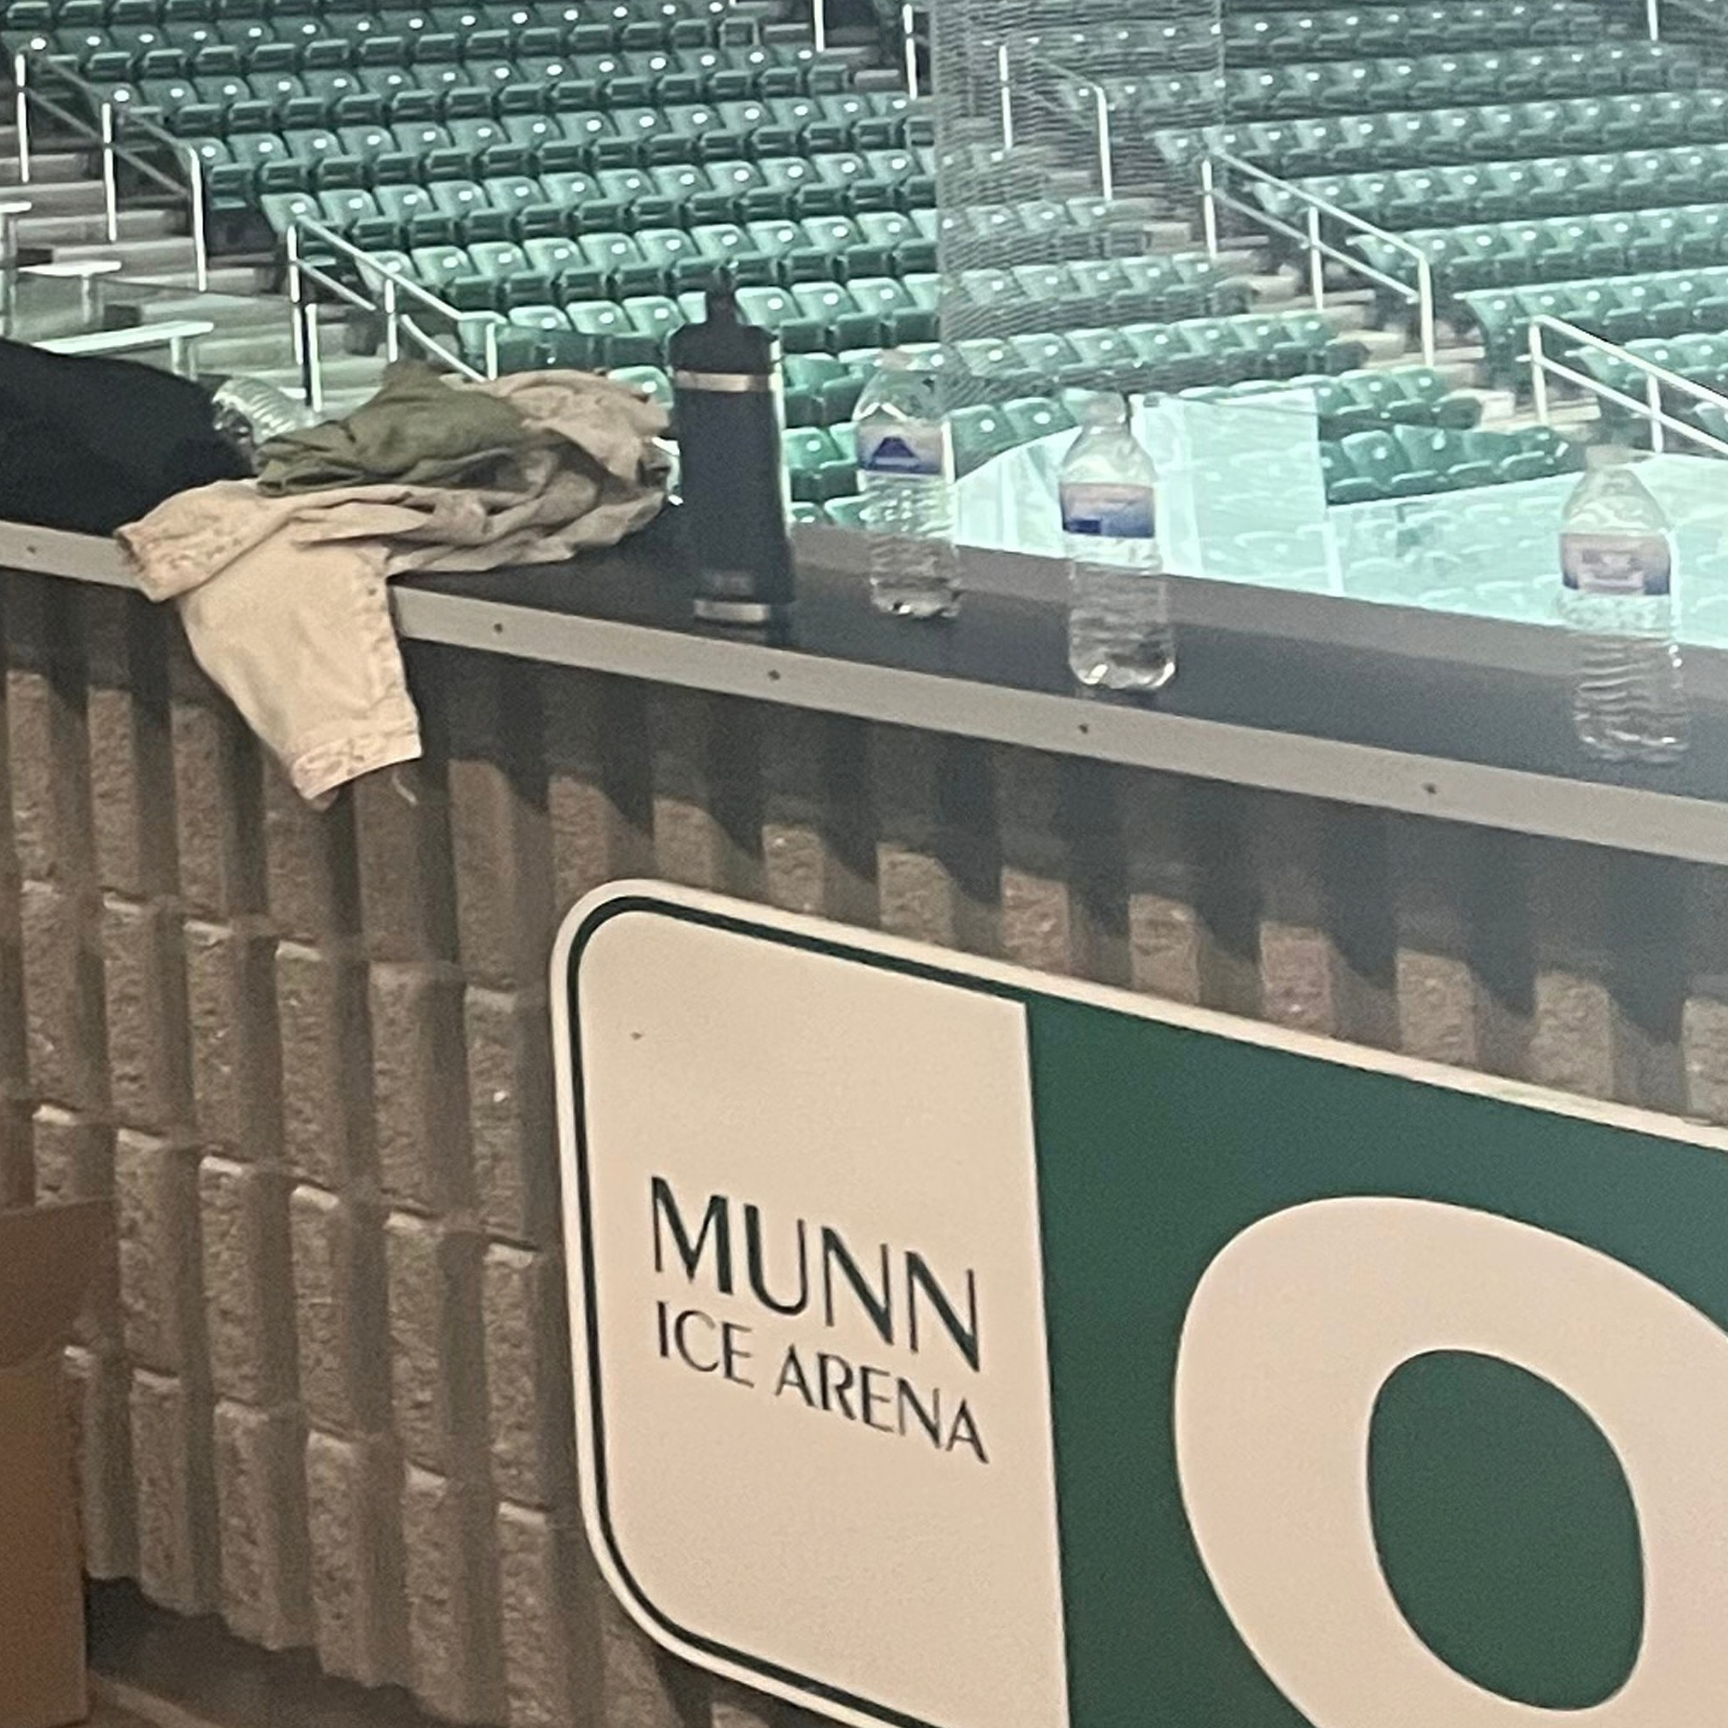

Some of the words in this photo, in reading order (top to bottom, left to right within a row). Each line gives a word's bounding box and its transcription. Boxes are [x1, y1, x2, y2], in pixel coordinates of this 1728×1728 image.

[650, 1175, 981, 1373] MUNN
[655, 1299, 756, 1389] ICE
[774, 1342, 990, 1465] ARENA
